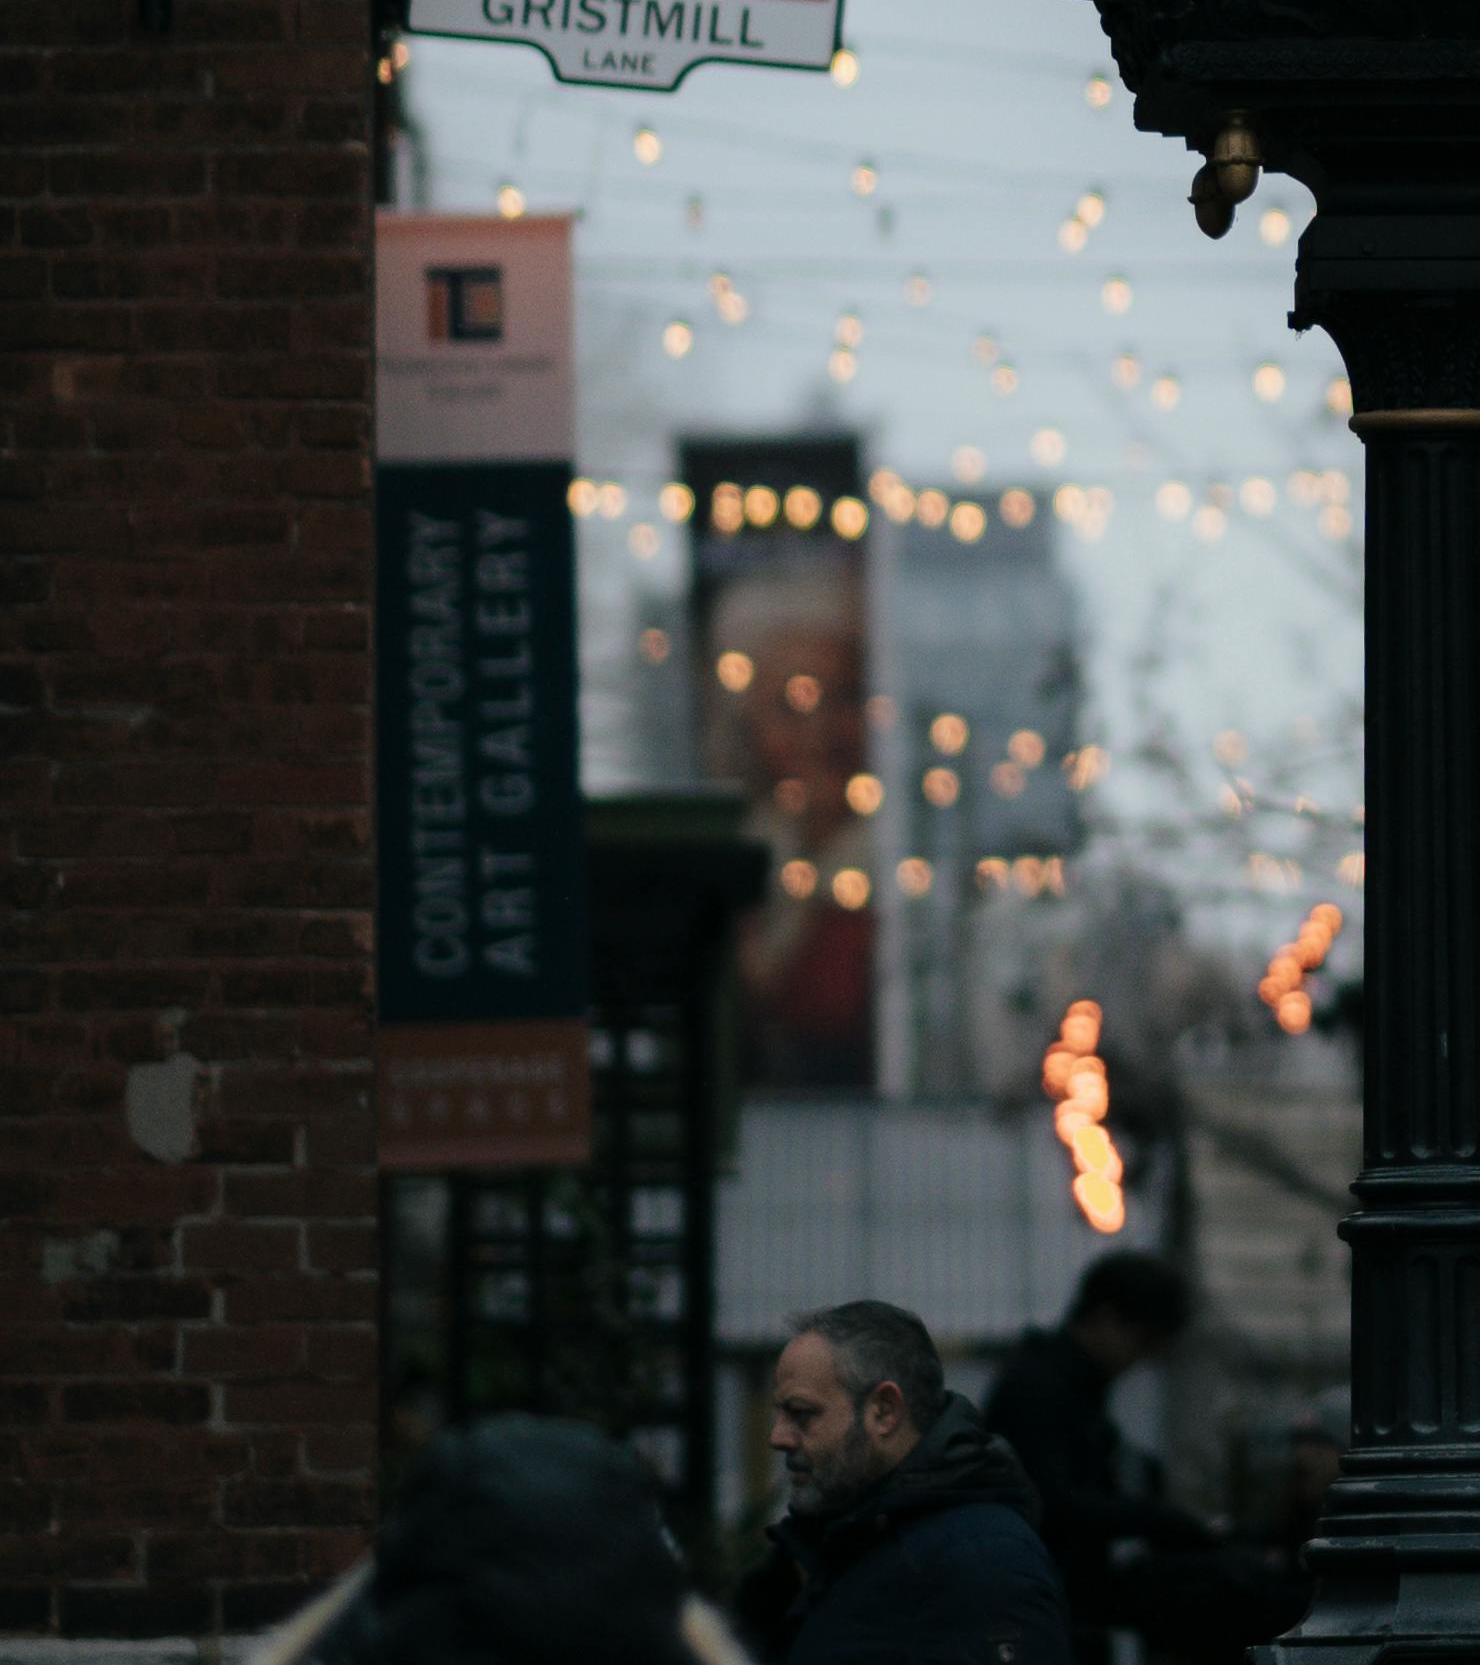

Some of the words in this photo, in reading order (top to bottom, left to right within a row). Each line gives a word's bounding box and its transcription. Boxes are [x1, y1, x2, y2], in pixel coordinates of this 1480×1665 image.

[582, 48, 656, 76] LANE
[408, 509, 469, 977] CONTEMPORARY
[474, 507, 536, 817] GALLERY
[479, 844, 538, 978] ART
